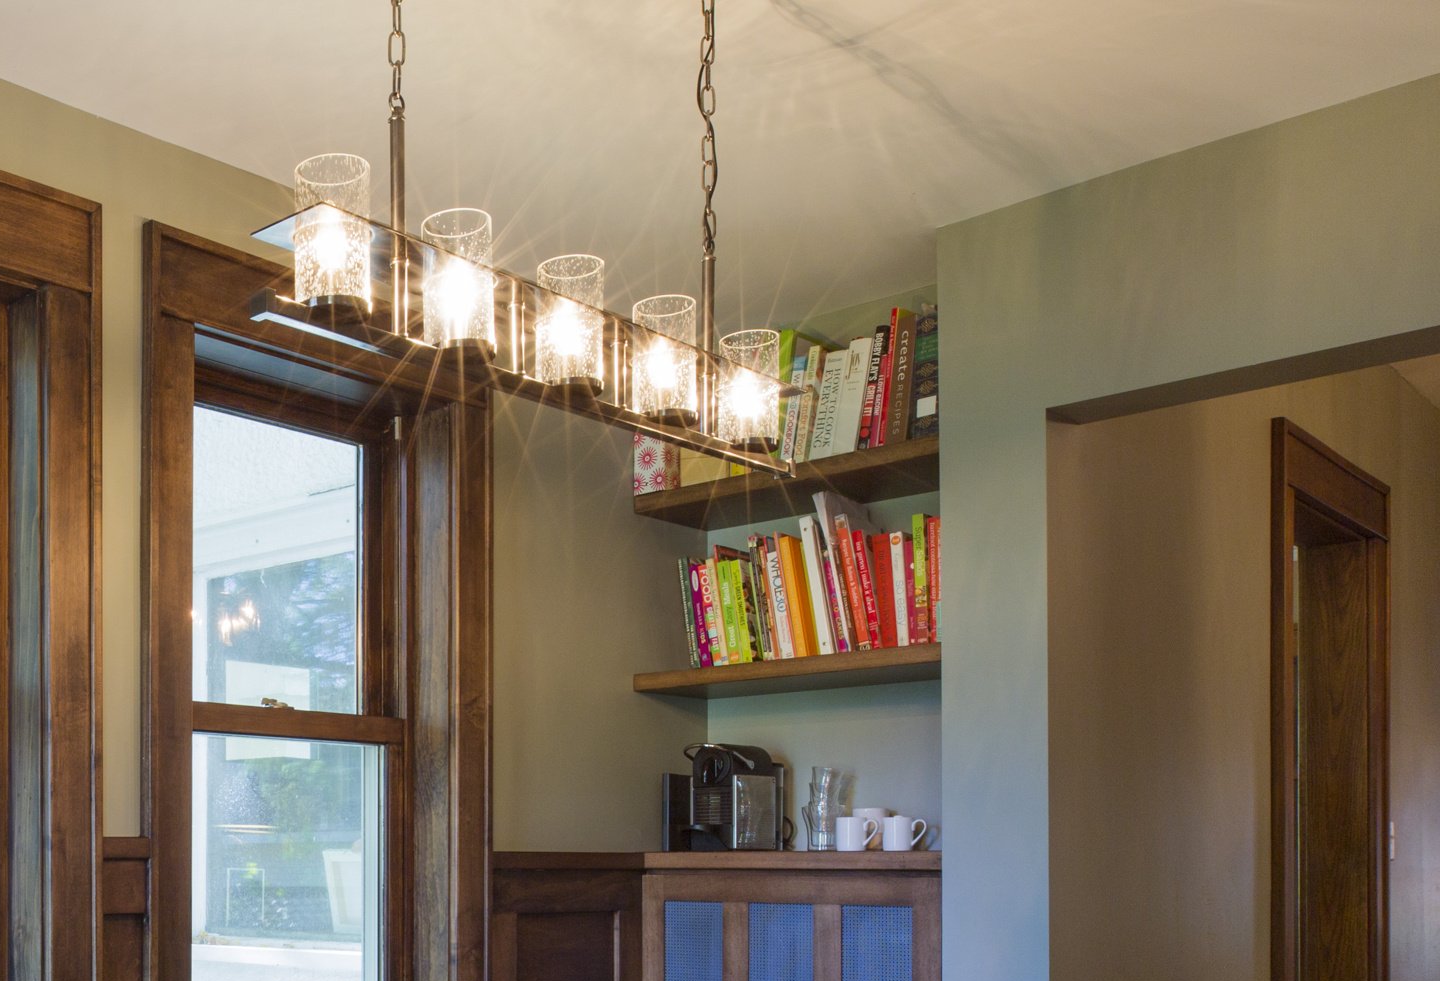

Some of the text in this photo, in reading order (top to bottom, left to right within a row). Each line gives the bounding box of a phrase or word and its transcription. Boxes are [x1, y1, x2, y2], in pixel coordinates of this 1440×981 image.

[873, 332, 884, 357] BOBBY
[869, 357, 880, 381] FLAY'S
[876, 377, 884, 393] LOVE
[893, 330, 909, 435] create RECIPES
[813, 369, 833, 449] EVERYTHING
[822, 368, 841, 448] HOW TO COOK
[865, 385, 876, 407] GRILL
[783, 409, 796, 456] COOKBOOK
[795, 394, 811, 456] Comfort Food
[856, 551, 865, 570] garten
[915, 526, 924, 577] Super Salads
[700, 568, 712, 603] FOOD
[770, 556, 786, 613] WHOLE30
[861, 573, 870, 590] make
[722, 582, 737, 648] Great Easy Meals
[865, 596, 876, 613] ahead
